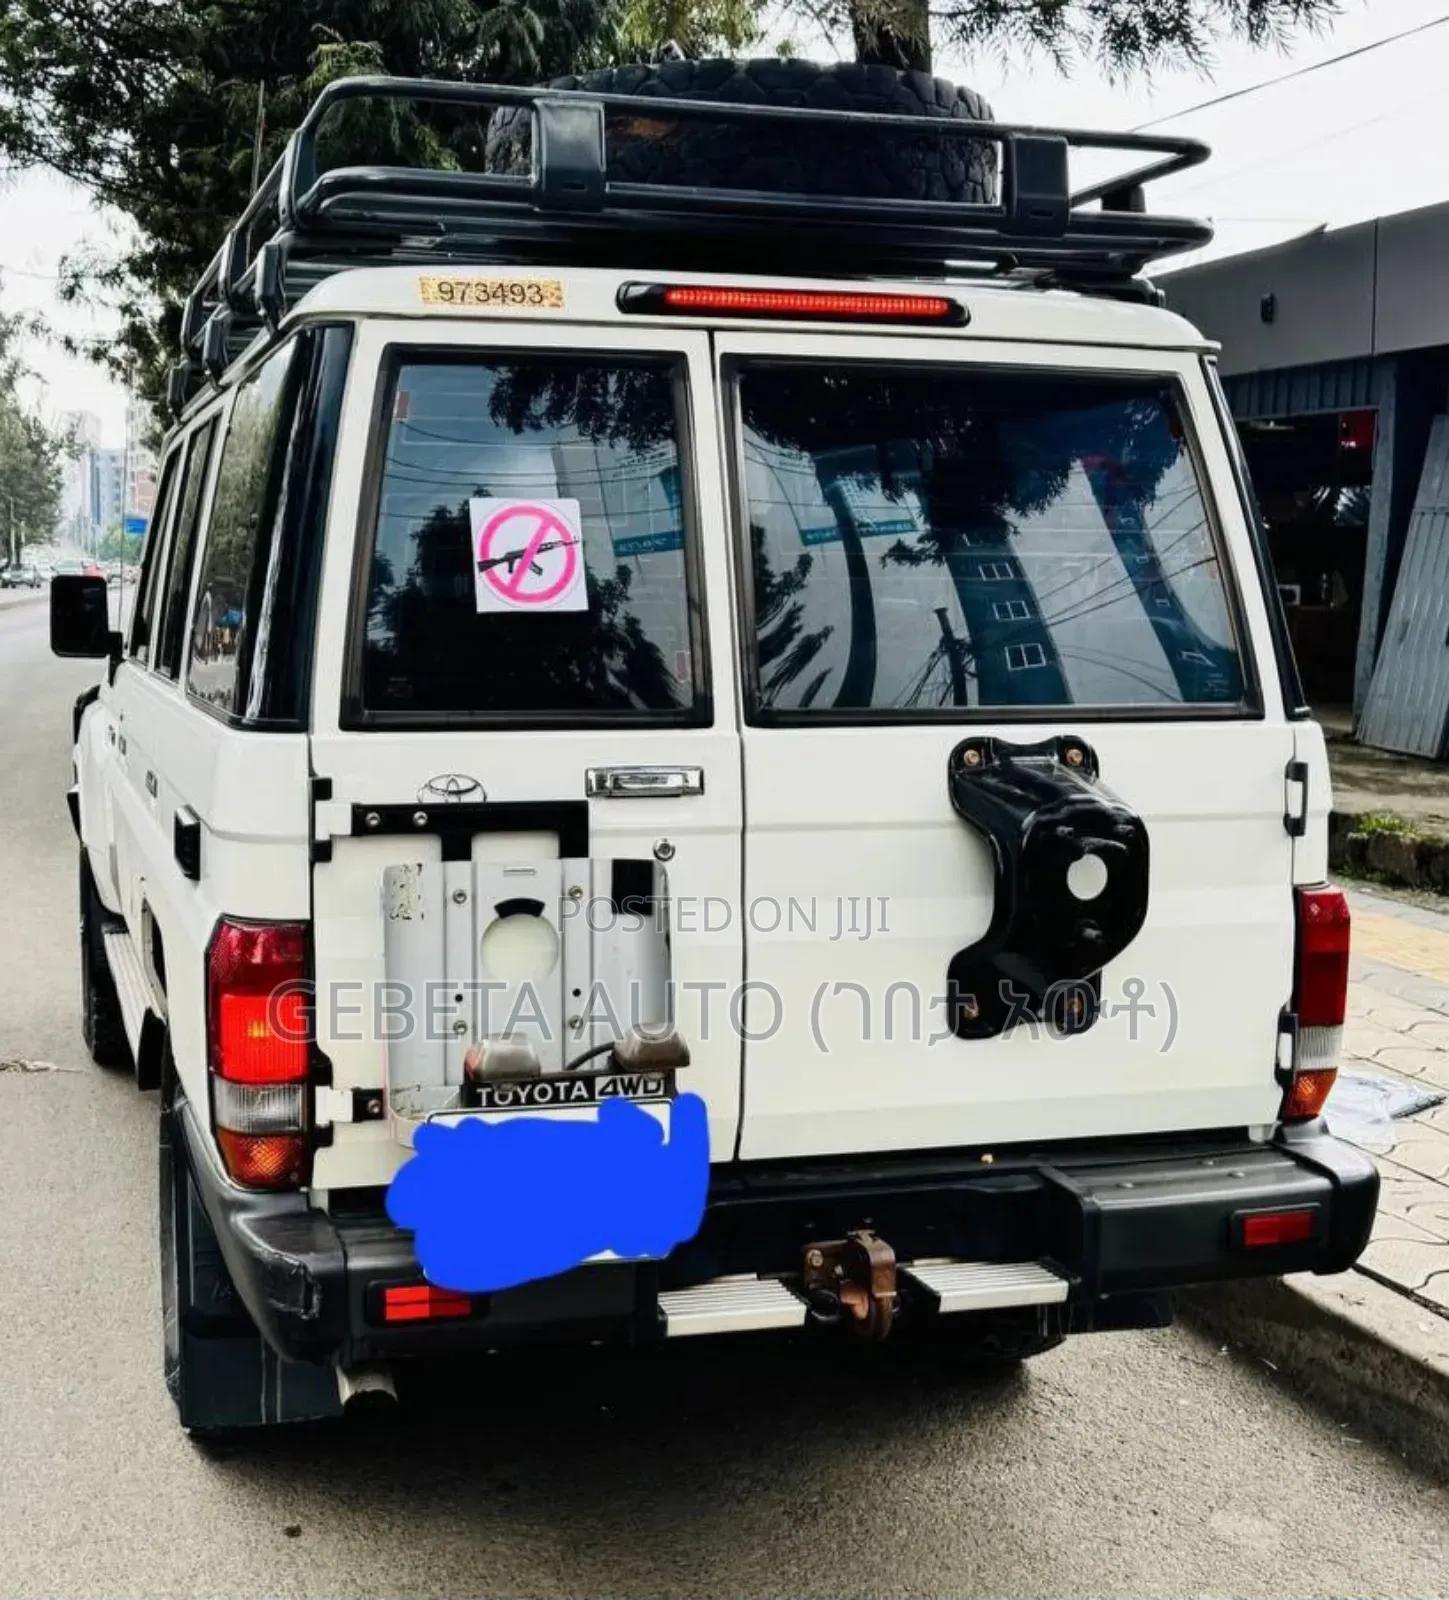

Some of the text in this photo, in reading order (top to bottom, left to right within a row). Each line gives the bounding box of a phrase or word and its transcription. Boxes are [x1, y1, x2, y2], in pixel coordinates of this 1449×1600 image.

[437, 281, 544, 304] 973493
[476, 1076, 662, 1107] TOYOTA 4WD
